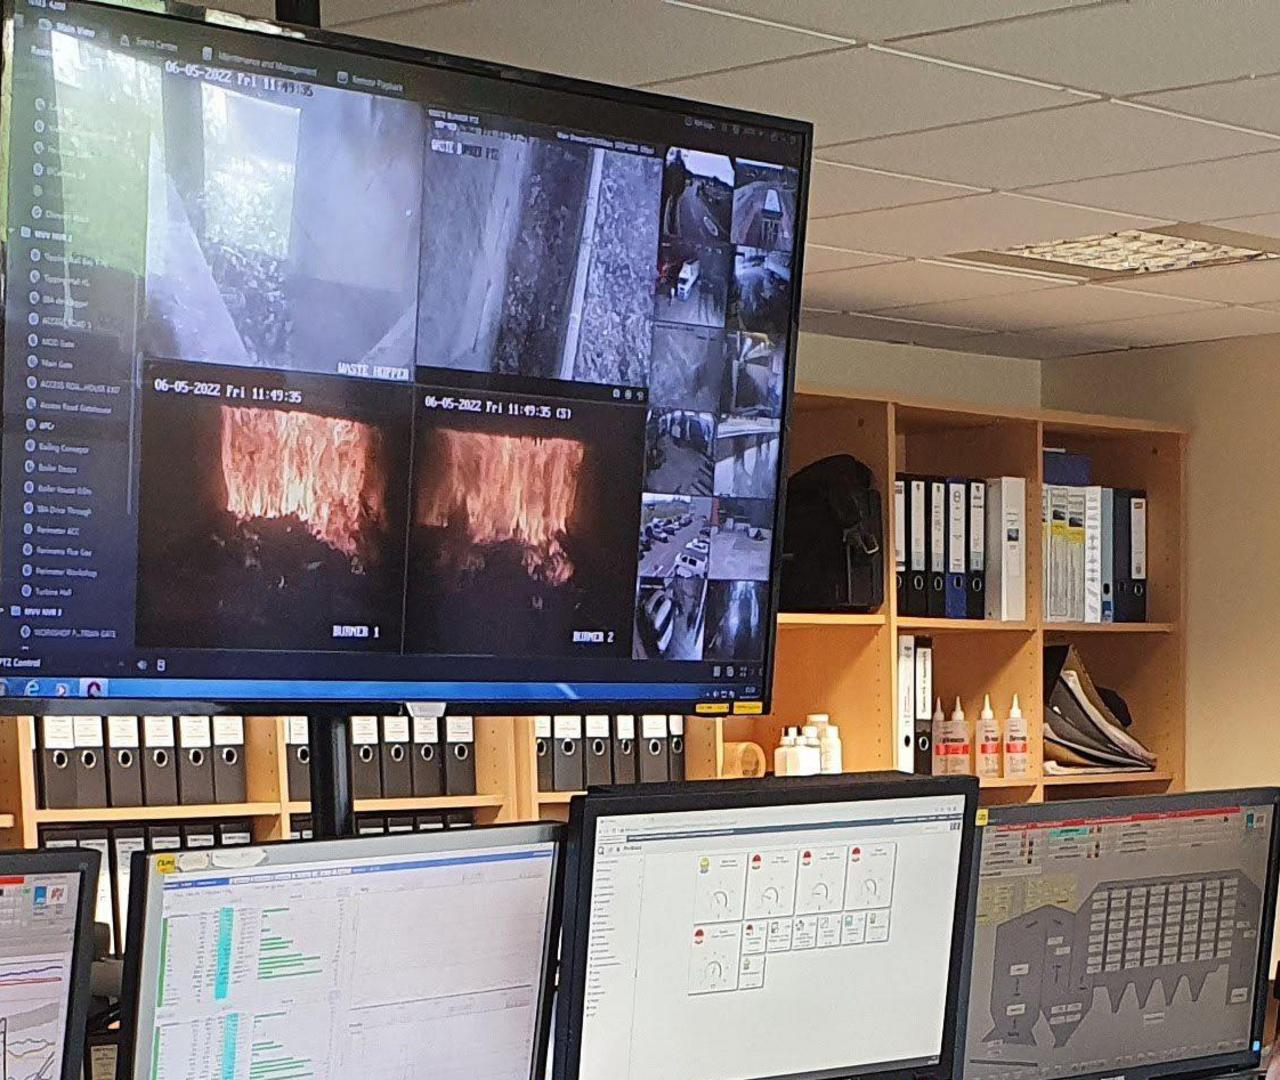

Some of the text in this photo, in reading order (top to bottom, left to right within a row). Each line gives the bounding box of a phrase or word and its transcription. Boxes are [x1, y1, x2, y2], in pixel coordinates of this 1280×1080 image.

[165, 60, 233, 83] 06-05-2022
[238, 71, 257, 88] Fri
[154, 378, 302, 403] 06-05-2022 Fri 11:49:35
[424, 395, 481, 413] 06-05-2022
[486, 399, 503, 414] Fri
[507, 401, 552, 419] 11:49:35
[373, 626, 380, 638] 1
[607, 631, 614, 643] 2
